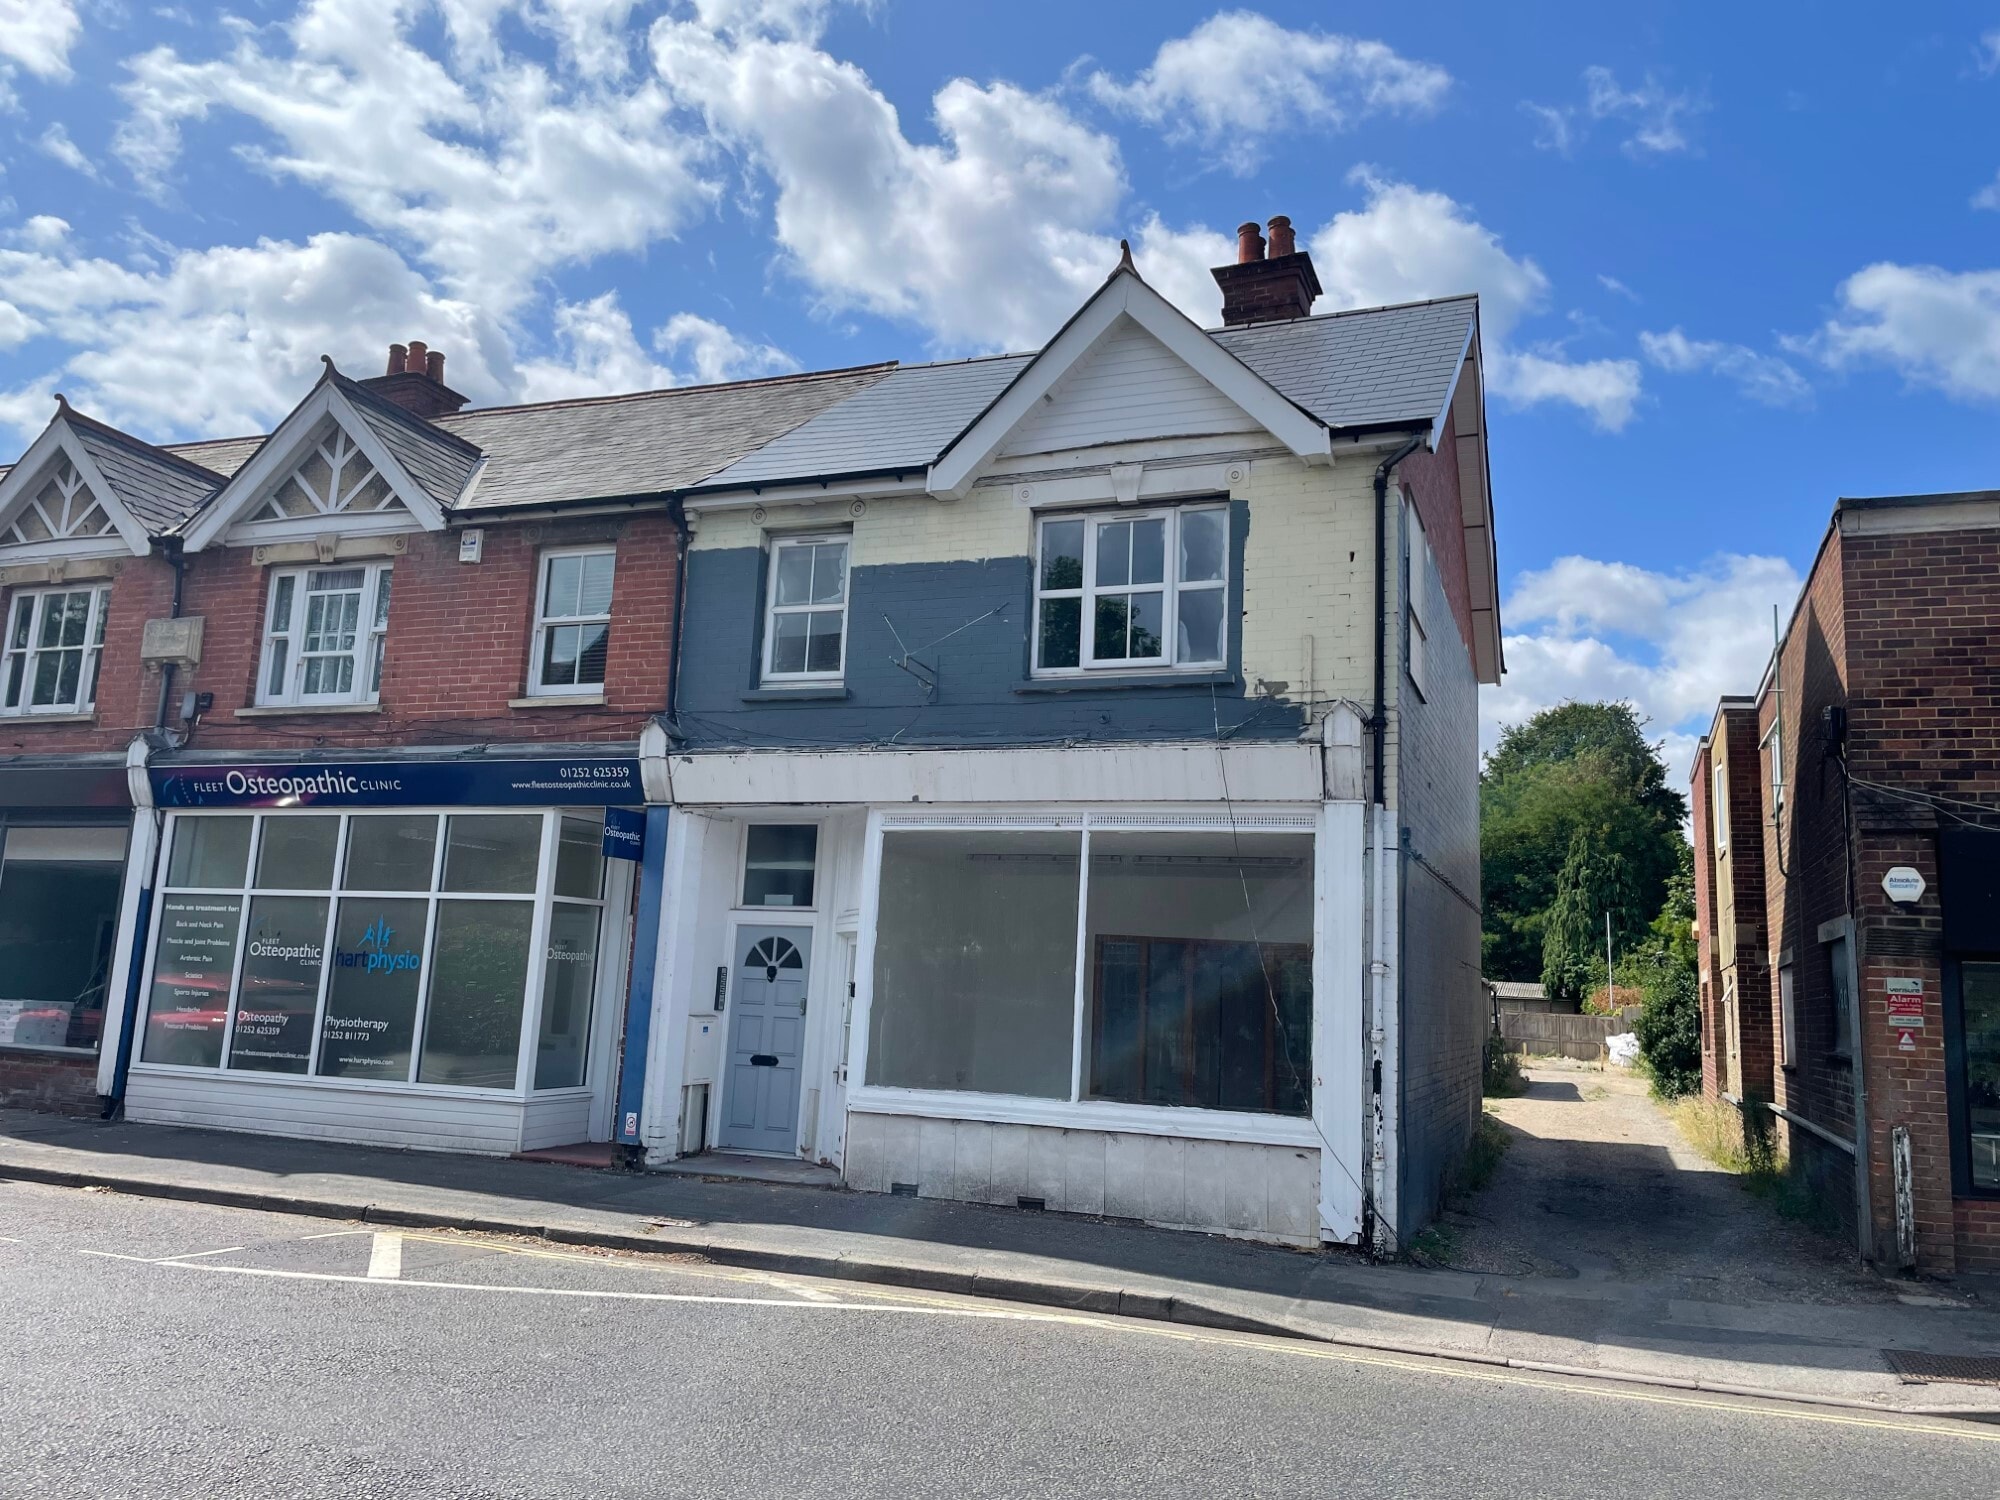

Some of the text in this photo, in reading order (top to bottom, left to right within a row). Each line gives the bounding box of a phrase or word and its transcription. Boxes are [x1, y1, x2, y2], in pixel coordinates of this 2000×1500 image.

[560, 766, 629, 778] 01252 625359
[194, 769, 402, 800] FLEET Osteopathic CLINIC
[511, 780, 632, 790] www.fleetosteopathicclinic.co.uk
[604, 826, 641, 842] Osteopathic
[249, 941, 321, 961] Osteopathic
[547, 947, 593, 964] Osteopathic
[335, 947, 420, 975] hartphysio
[1890, 995, 1921, 1003] Alarm
[238, 1010, 289, 1026] Osteopathy
[325, 1015, 389, 1032] Physiotherapy
[235, 1025, 281, 1035] 01252 625359
[322, 1030, 370, 1041] 01252 811773
